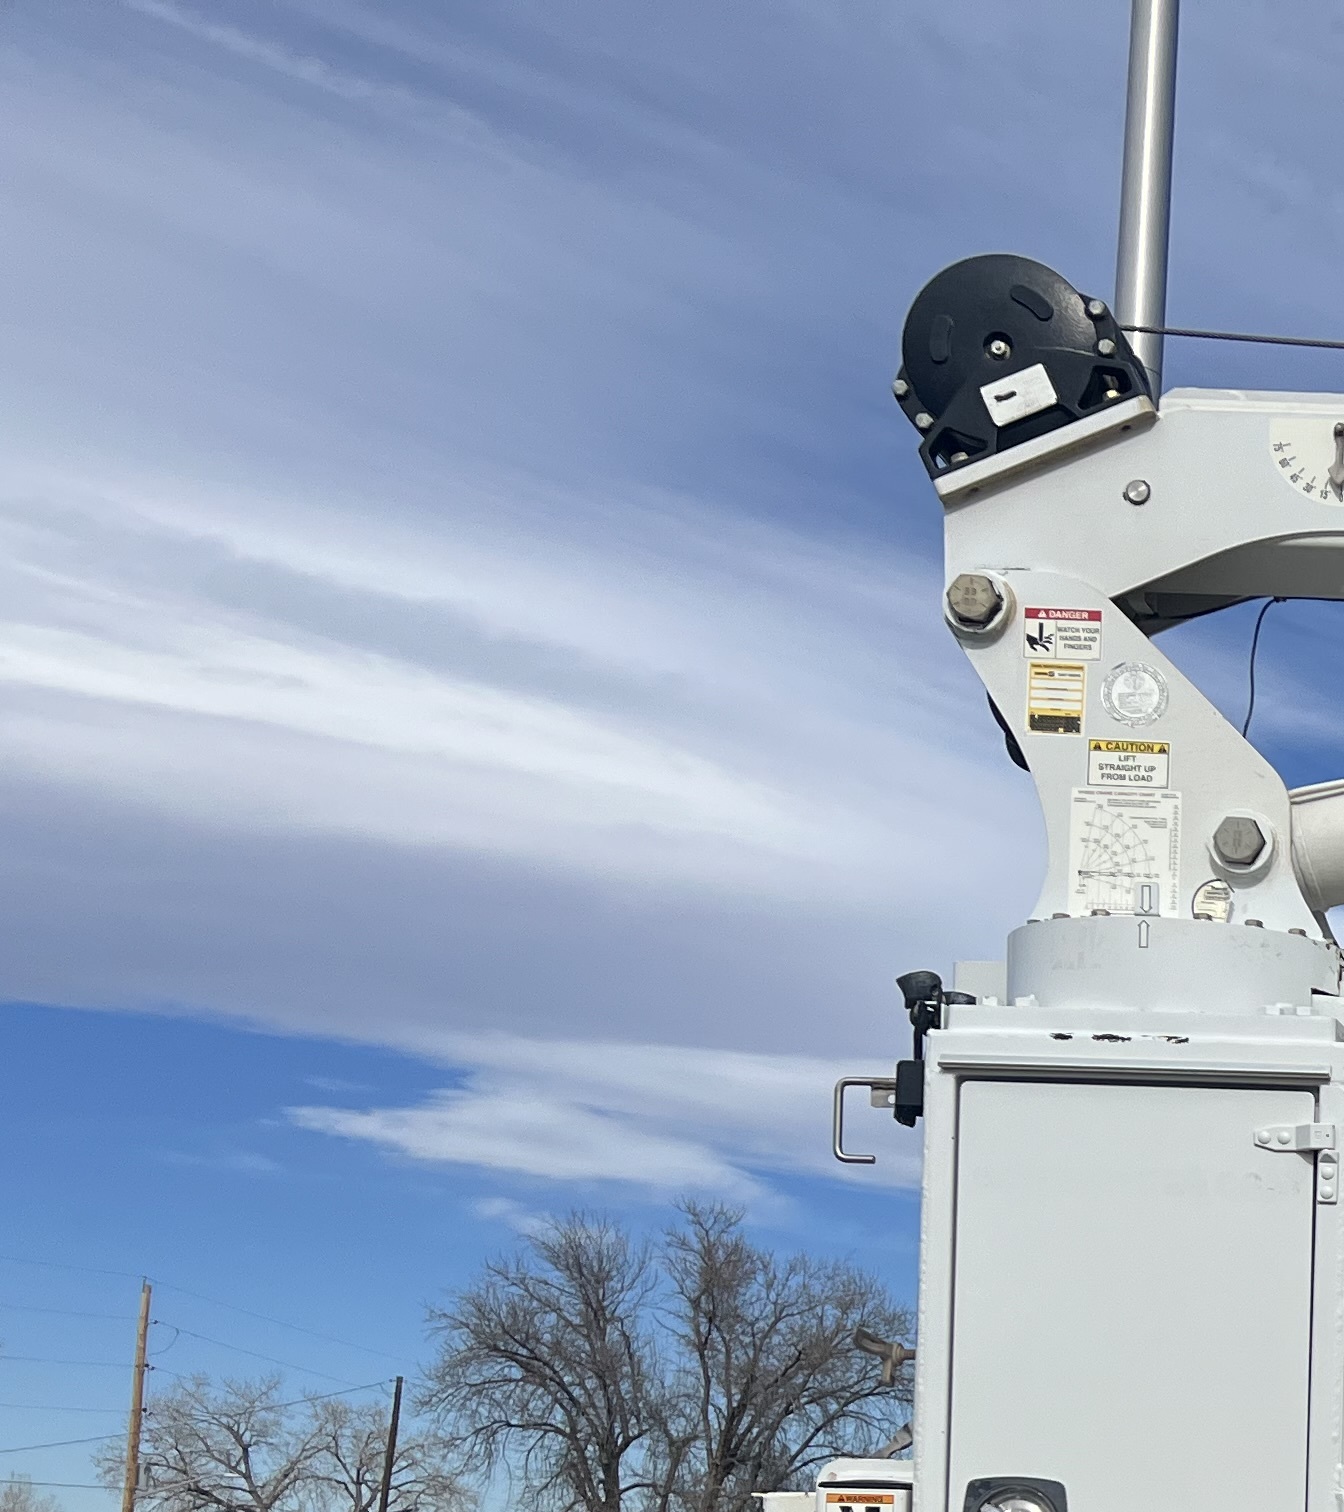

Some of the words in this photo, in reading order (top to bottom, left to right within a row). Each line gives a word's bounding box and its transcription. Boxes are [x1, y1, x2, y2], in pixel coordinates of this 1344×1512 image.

[1049, 610, 1089, 619] DANGER
[1106, 741, 1154, 752] CAUTION
[1098, 763, 1142, 772] STRAIGHT
[1144, 765, 1157, 773] UP
[1101, 772, 1126, 780] FROM
[1128, 774, 1153, 782] LOAD
